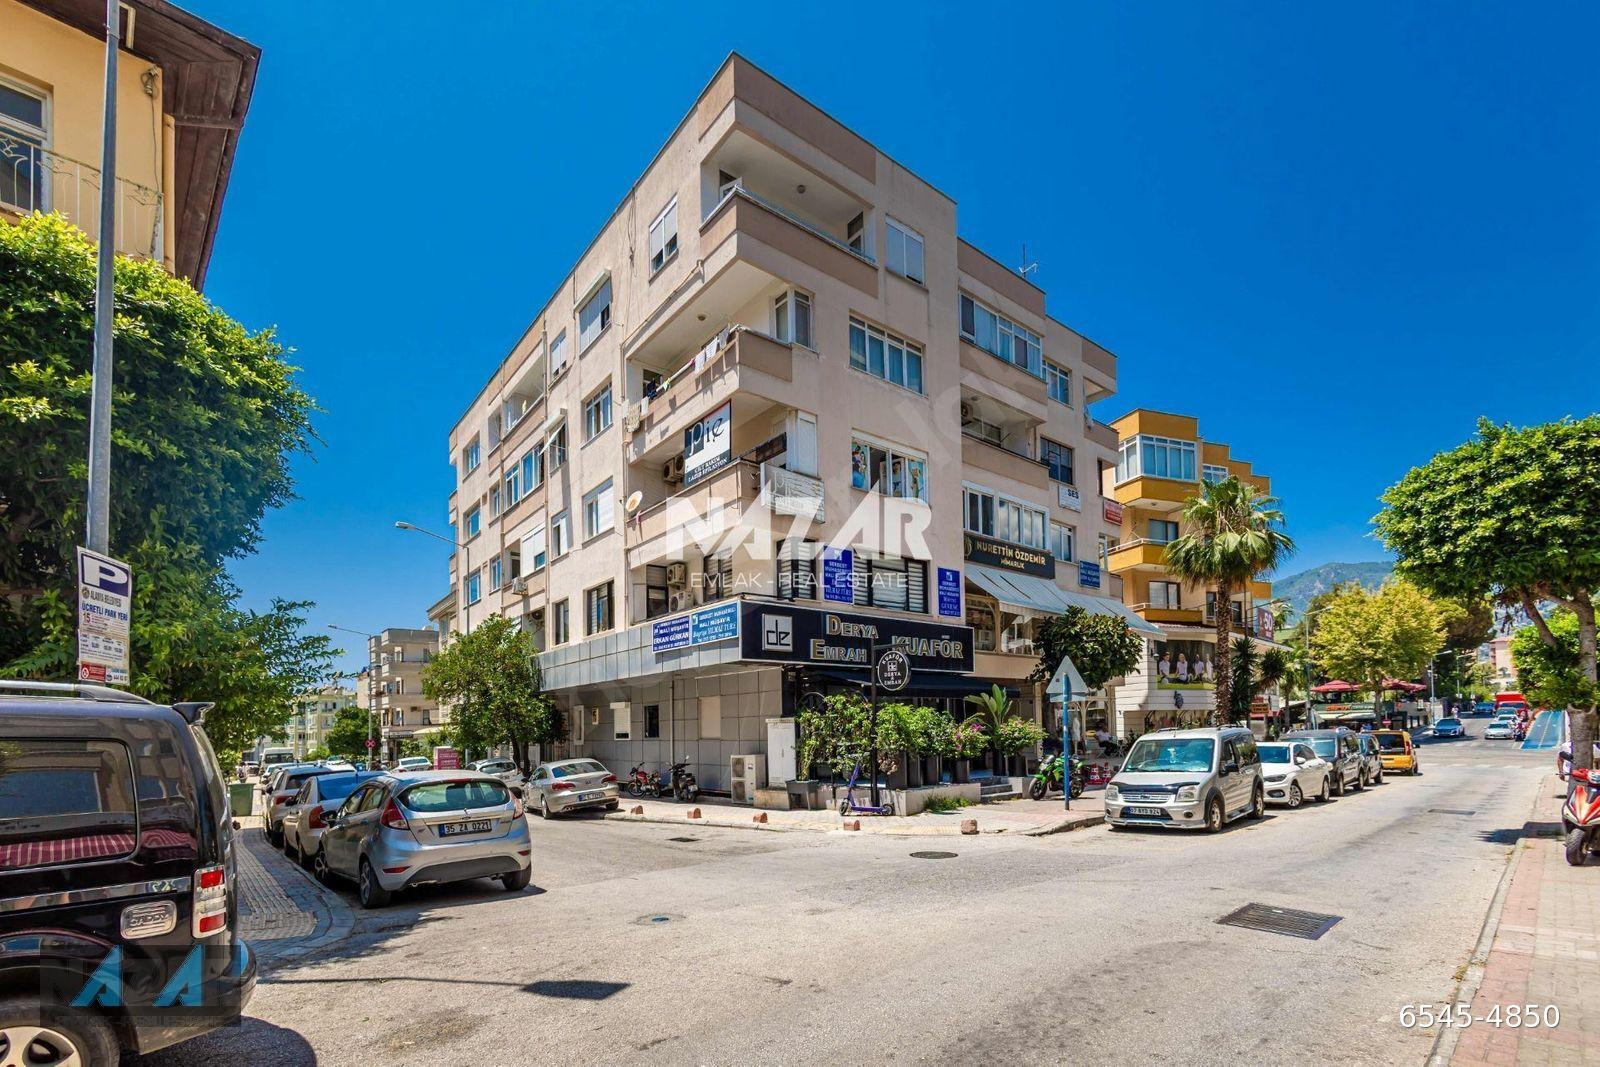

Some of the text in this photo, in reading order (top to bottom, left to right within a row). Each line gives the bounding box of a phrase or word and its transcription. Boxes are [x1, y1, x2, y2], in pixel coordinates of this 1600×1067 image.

[1067, 488, 1079, 499] SES
[977, 541, 1046, 566] NURETTİN ÖZDEMİR
[84, 555, 127, 587] P
[104, 607, 117, 619] PARK
[826, 615, 879, 639] DERYA
[810, 638, 867, 662] EMRAH
[445, 820, 490, 833] 35 ZA 0221
